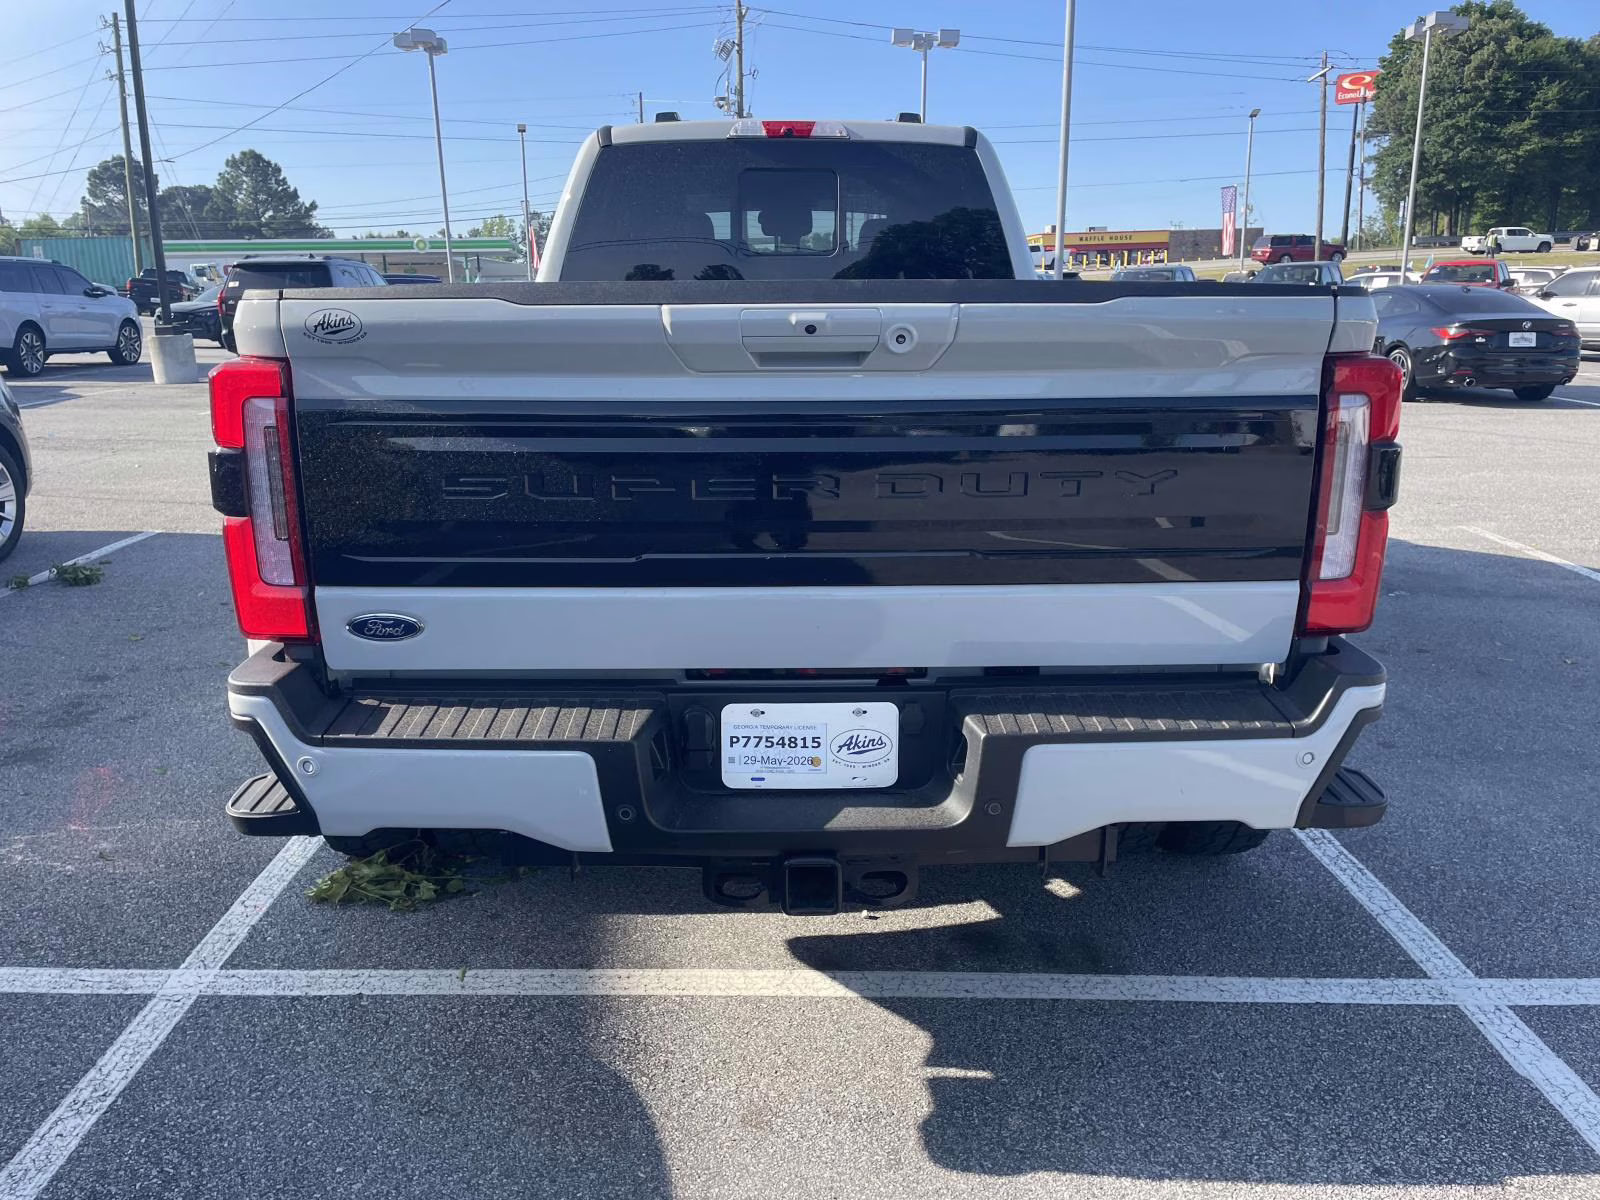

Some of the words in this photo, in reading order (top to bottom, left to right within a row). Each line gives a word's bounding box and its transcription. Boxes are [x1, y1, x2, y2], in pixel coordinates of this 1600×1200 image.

[313, 312, 355, 335] Akins
[441, 473, 841, 500] SUPER
[874, 469, 1178, 499] DUTY
[364, 619, 405, 636] Ford
[729, 735, 822, 749] P7754815
[836, 734, 887, 755] Akins
[743, 755, 813, 767] 29-May-2026
